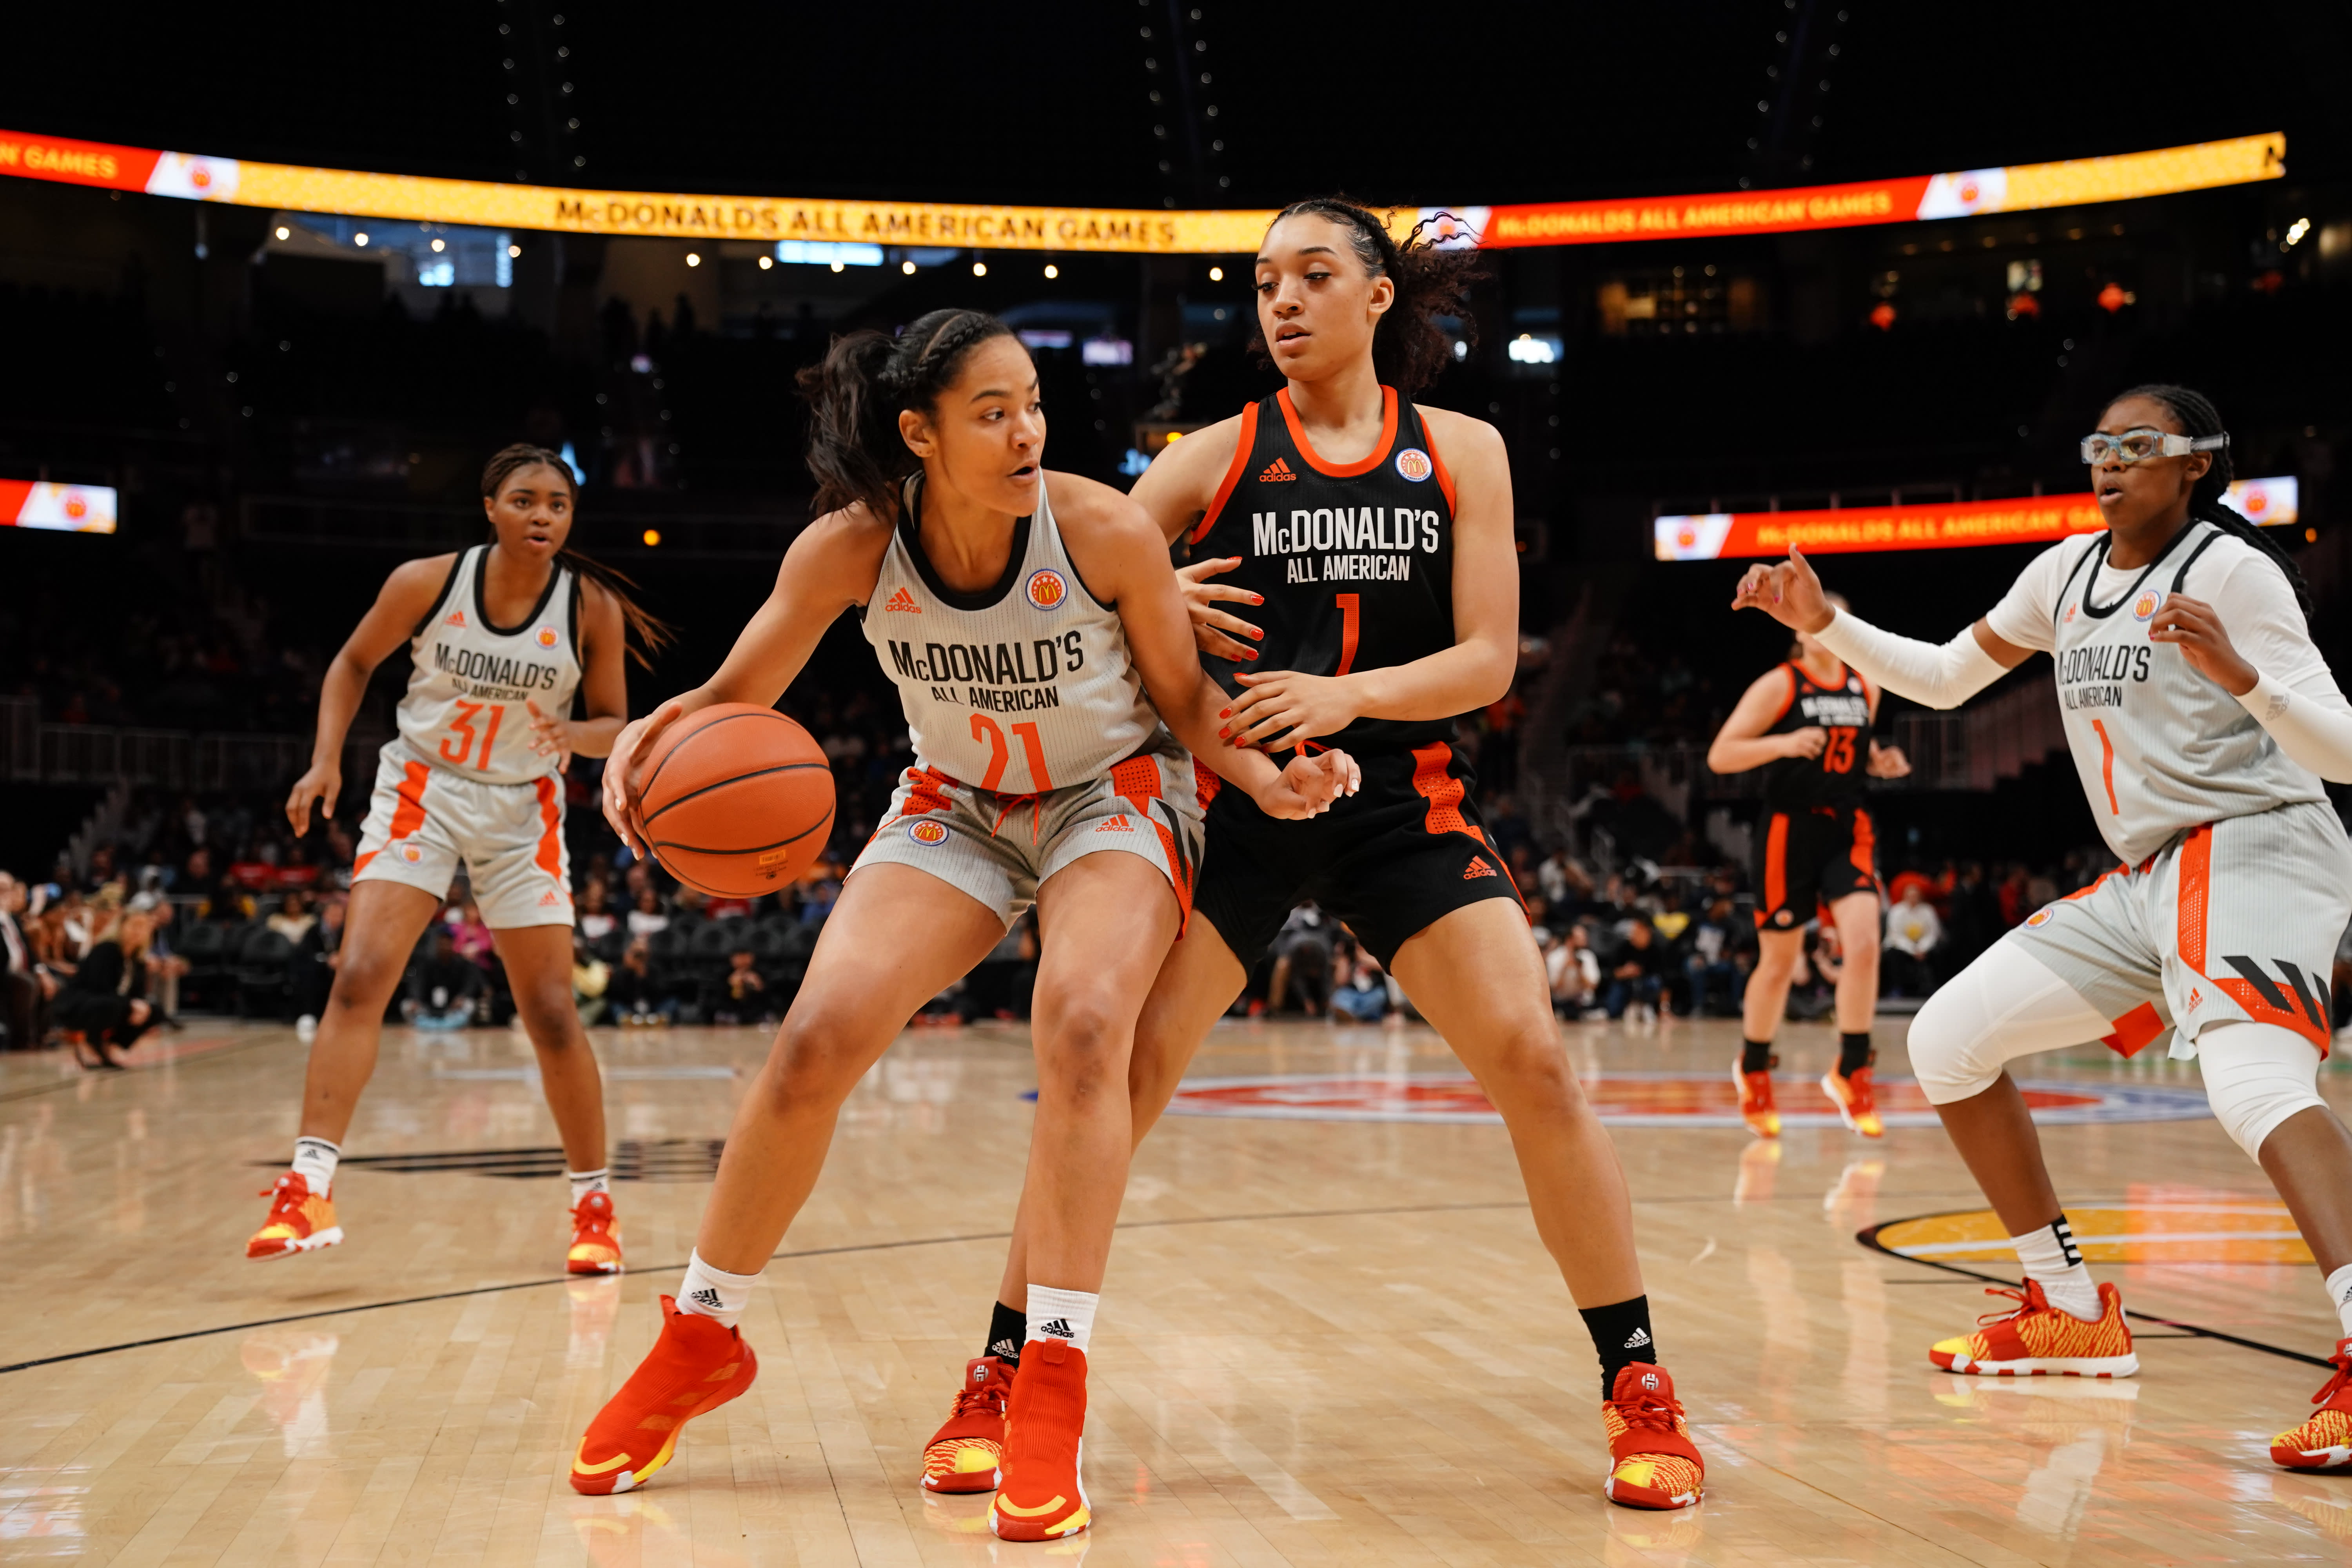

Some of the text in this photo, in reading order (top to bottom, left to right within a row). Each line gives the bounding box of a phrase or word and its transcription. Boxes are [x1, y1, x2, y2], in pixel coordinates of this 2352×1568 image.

[24, 145, 118, 180] GAMES
[557, 200, 1174, 242] McDONALDS ALL AMERICAN GAMES
[1638, 206, 1678, 232] ALL
[1682, 199, 1805, 228] AMERICAN
[1808, 190, 1892, 220] GAMES
[1259, 472, 1296, 482] adidas
[1253, 507, 1439, 556] McDONALD'S
[1898, 516, 1937, 541] ALL
[1943, 508, 2062, 538] AMERICAN
[1287, 555, 1410, 583] ALL AMERICAN
[885, 602, 922, 614] adidas
[1335, 593, 1359, 677] 1
[435, 643, 557, 690] McDONALD'S
[888, 630, 1083, 684] McDONALD'S
[471, 684, 528, 702] AMERICAN
[931, 686, 1059, 712] ALL AMERICAN
[2065, 686, 2122, 711] ALL AMERICAN
[439, 699, 505, 771] 31
[969, 713, 1053, 792] 21
[1824, 726, 1858, 775] 13
[2092, 719, 2119, 815] 1
[1041, 1326, 1074, 1338] adidas
[1624, 1336, 1651, 1348] adidas
[992, 1345, 1019, 1359] adidas
